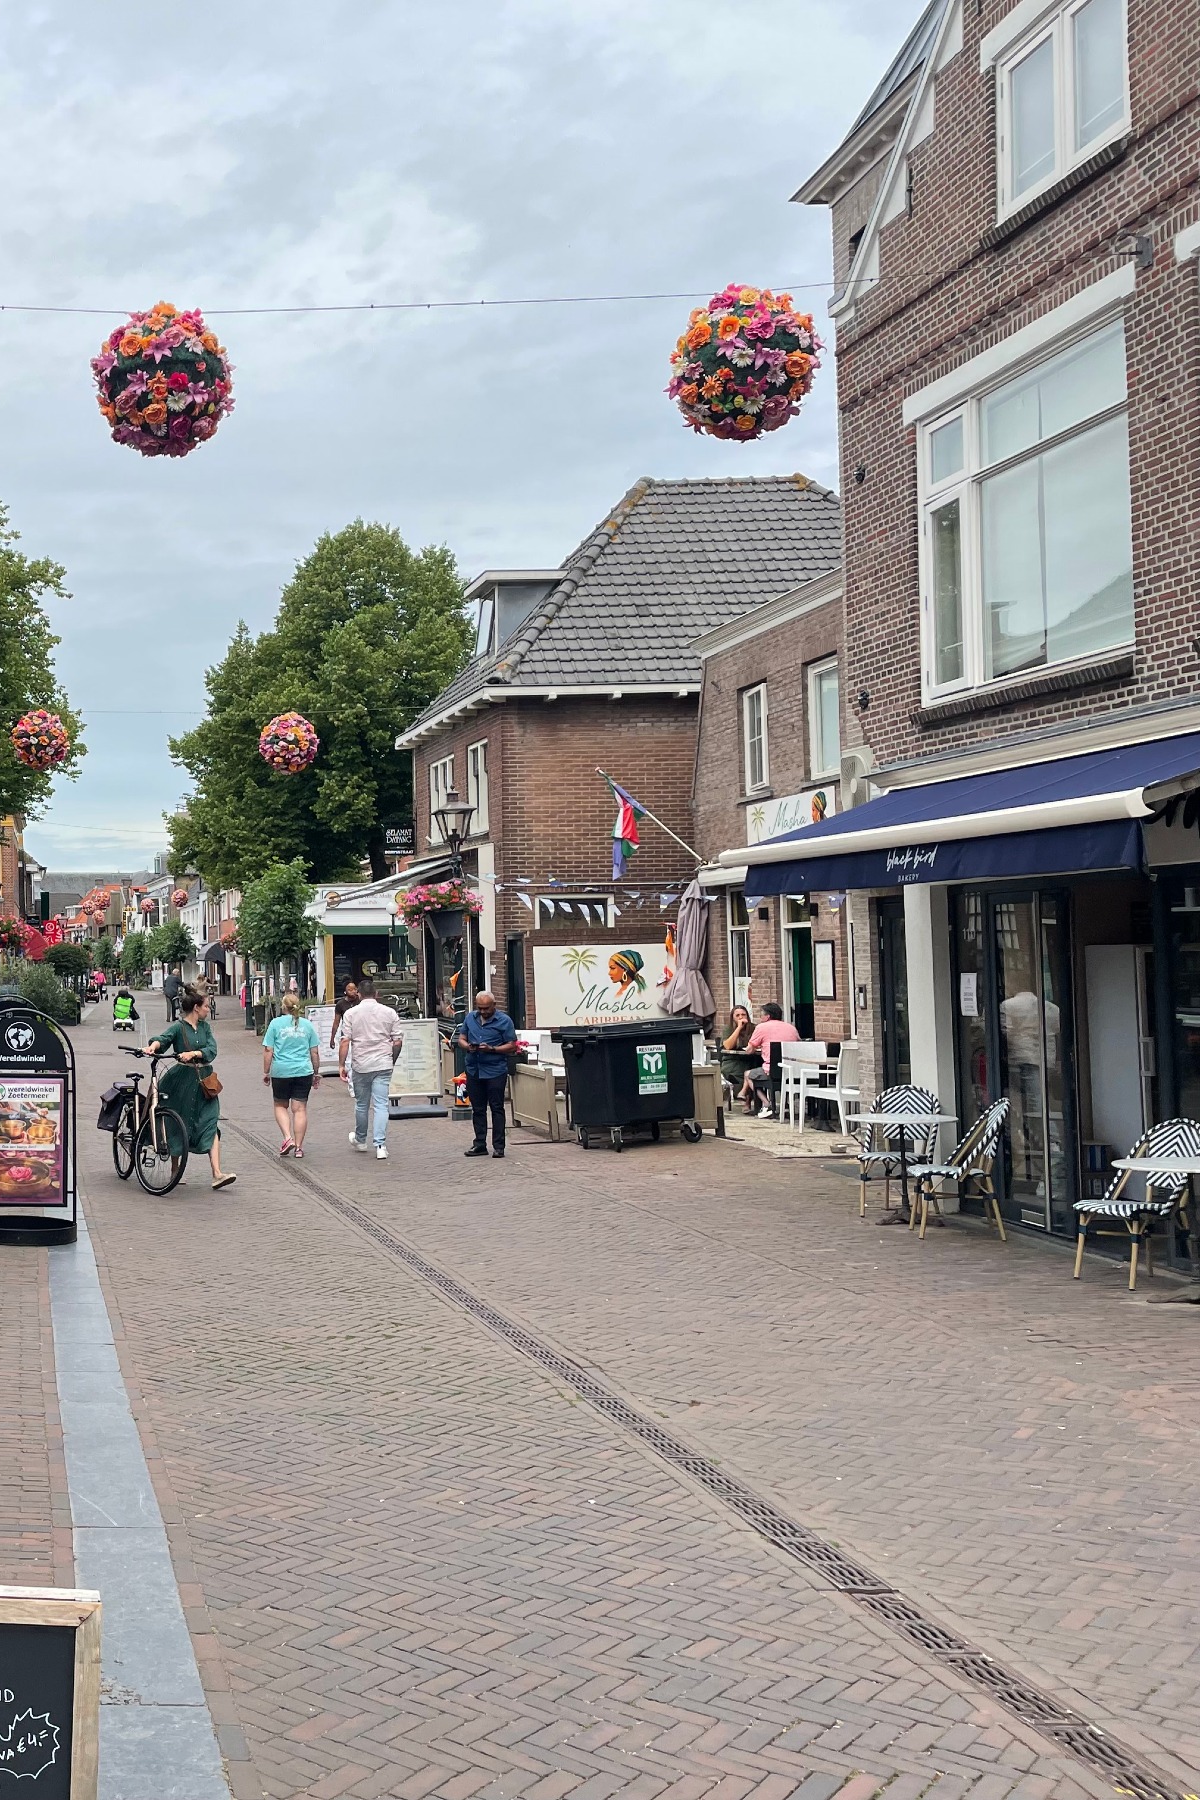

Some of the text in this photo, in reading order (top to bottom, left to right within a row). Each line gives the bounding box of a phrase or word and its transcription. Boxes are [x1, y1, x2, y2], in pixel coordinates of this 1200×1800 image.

[768, 799, 809, 836] Masha
[385, 836, 412, 844] DATANG
[886, 844, 939, 872] black bird
[897, 873, 919, 882] BAKERY
[564, 984, 653, 1015] Masha
[7, 1085, 55, 1093] wereldwinkel
